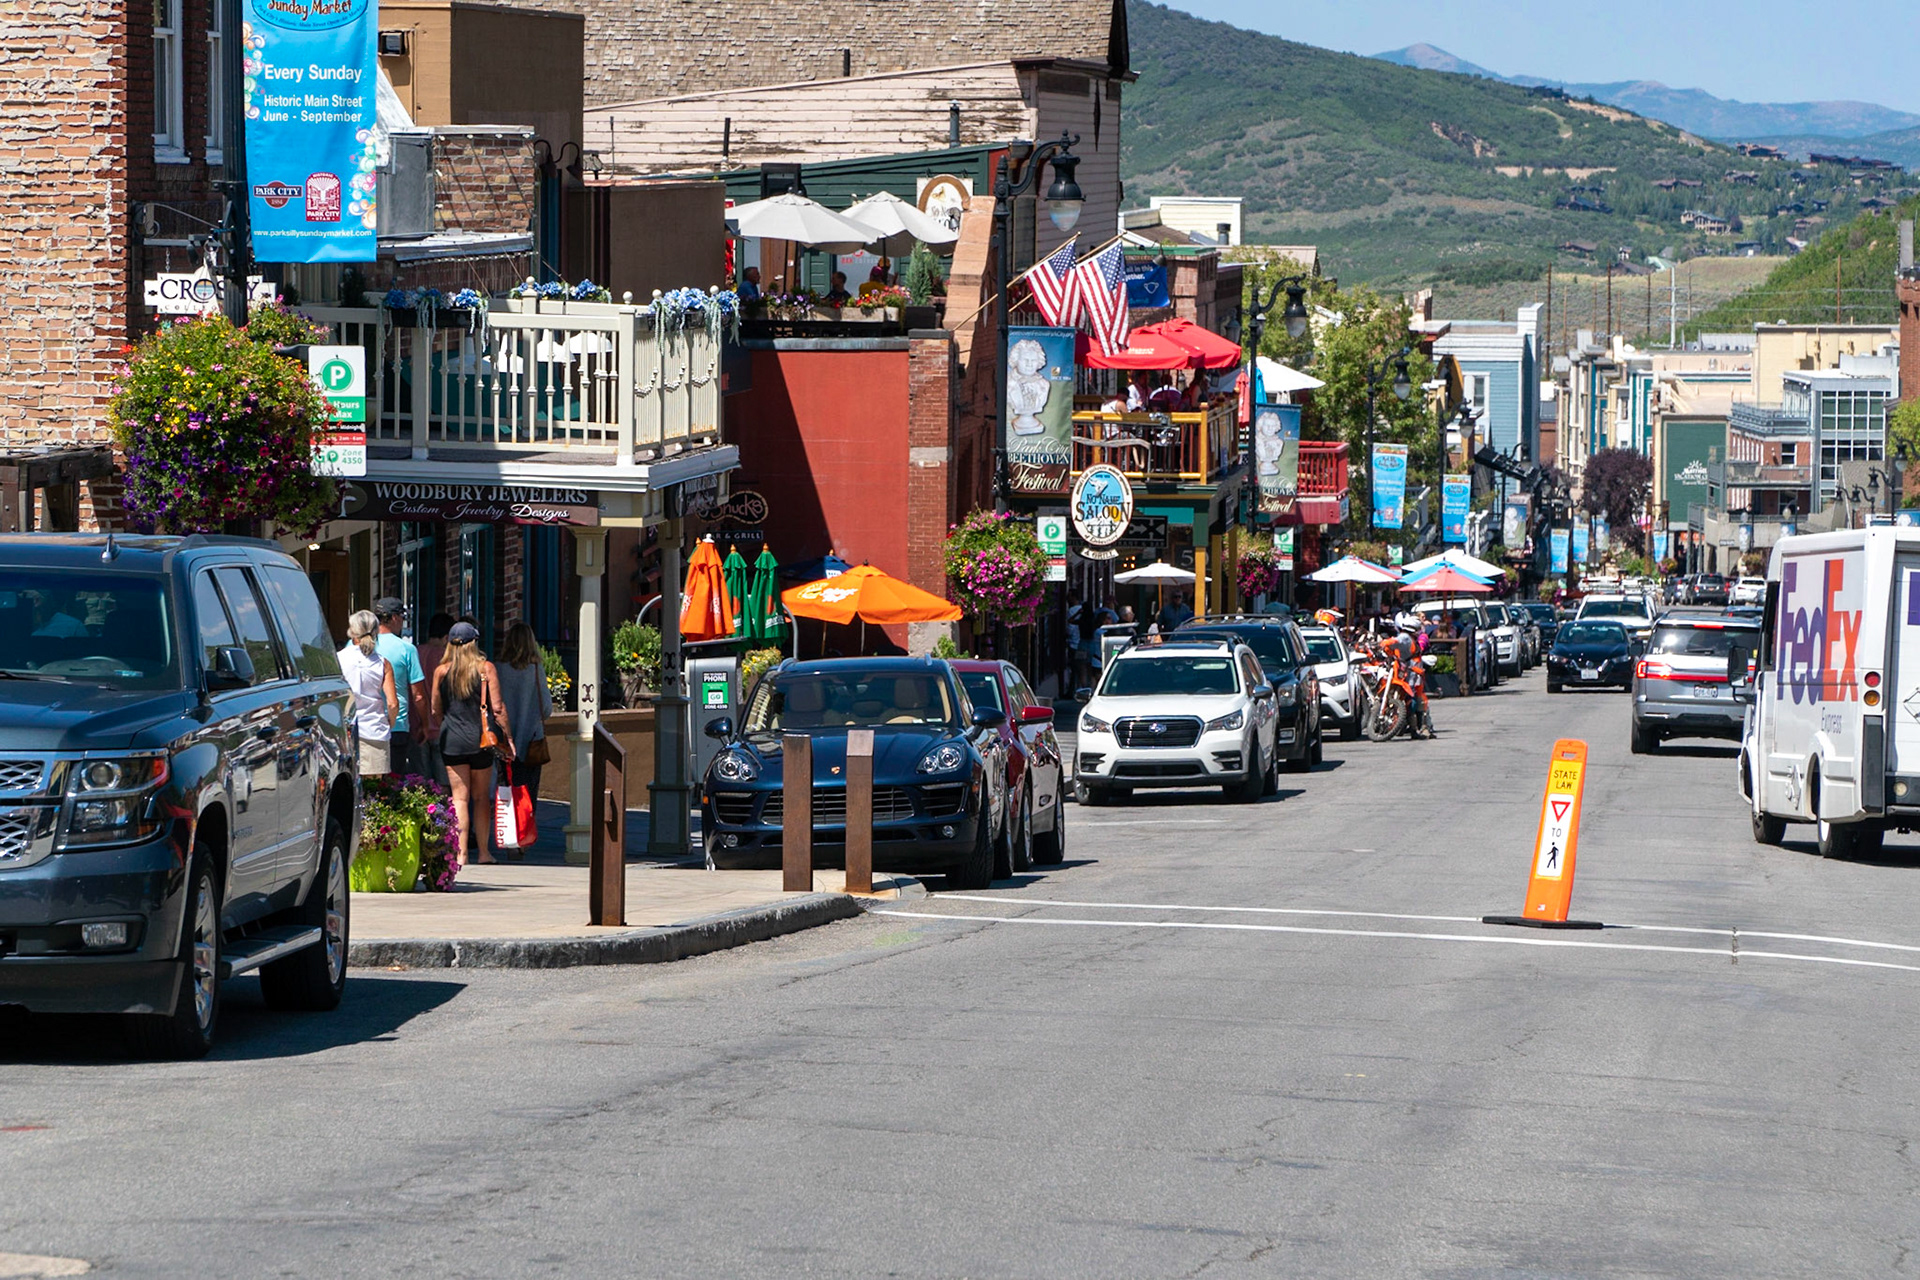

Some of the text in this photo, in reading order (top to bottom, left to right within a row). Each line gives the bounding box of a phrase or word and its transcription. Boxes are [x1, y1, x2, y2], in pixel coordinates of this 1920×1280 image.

[265, 64, 362, 83] Every Sunday
[264, 94, 362, 107] Historic Main Street
[263, 110, 288, 121] June
[301, 110, 362, 123] September
[280, 187, 300, 196] CITY
[254, 229, 372, 238] www.parksillysundaymarket.com
[160, 278, 260, 304] CROSY
[331, 366, 345, 386] P
[1010, 436, 1069, 455] Park City
[1008, 453, 1069, 464] BEETHOVEN
[1010, 463, 1066, 490] Festival
[374, 483, 588, 503] WOODBURY JEWELERS
[388, 500, 569, 522] Custom Jewelry Designs
[1074, 500, 1130, 522] SALOON
[1092, 550, 1113, 559] GRILL
[1777, 559, 1862, 705] FedEx
[1821, 706, 1842, 734] Express
[1554, 769, 1577, 780] STATE
[1556, 781, 1572, 790] LAW
[1552, 828, 1562, 837] TO
